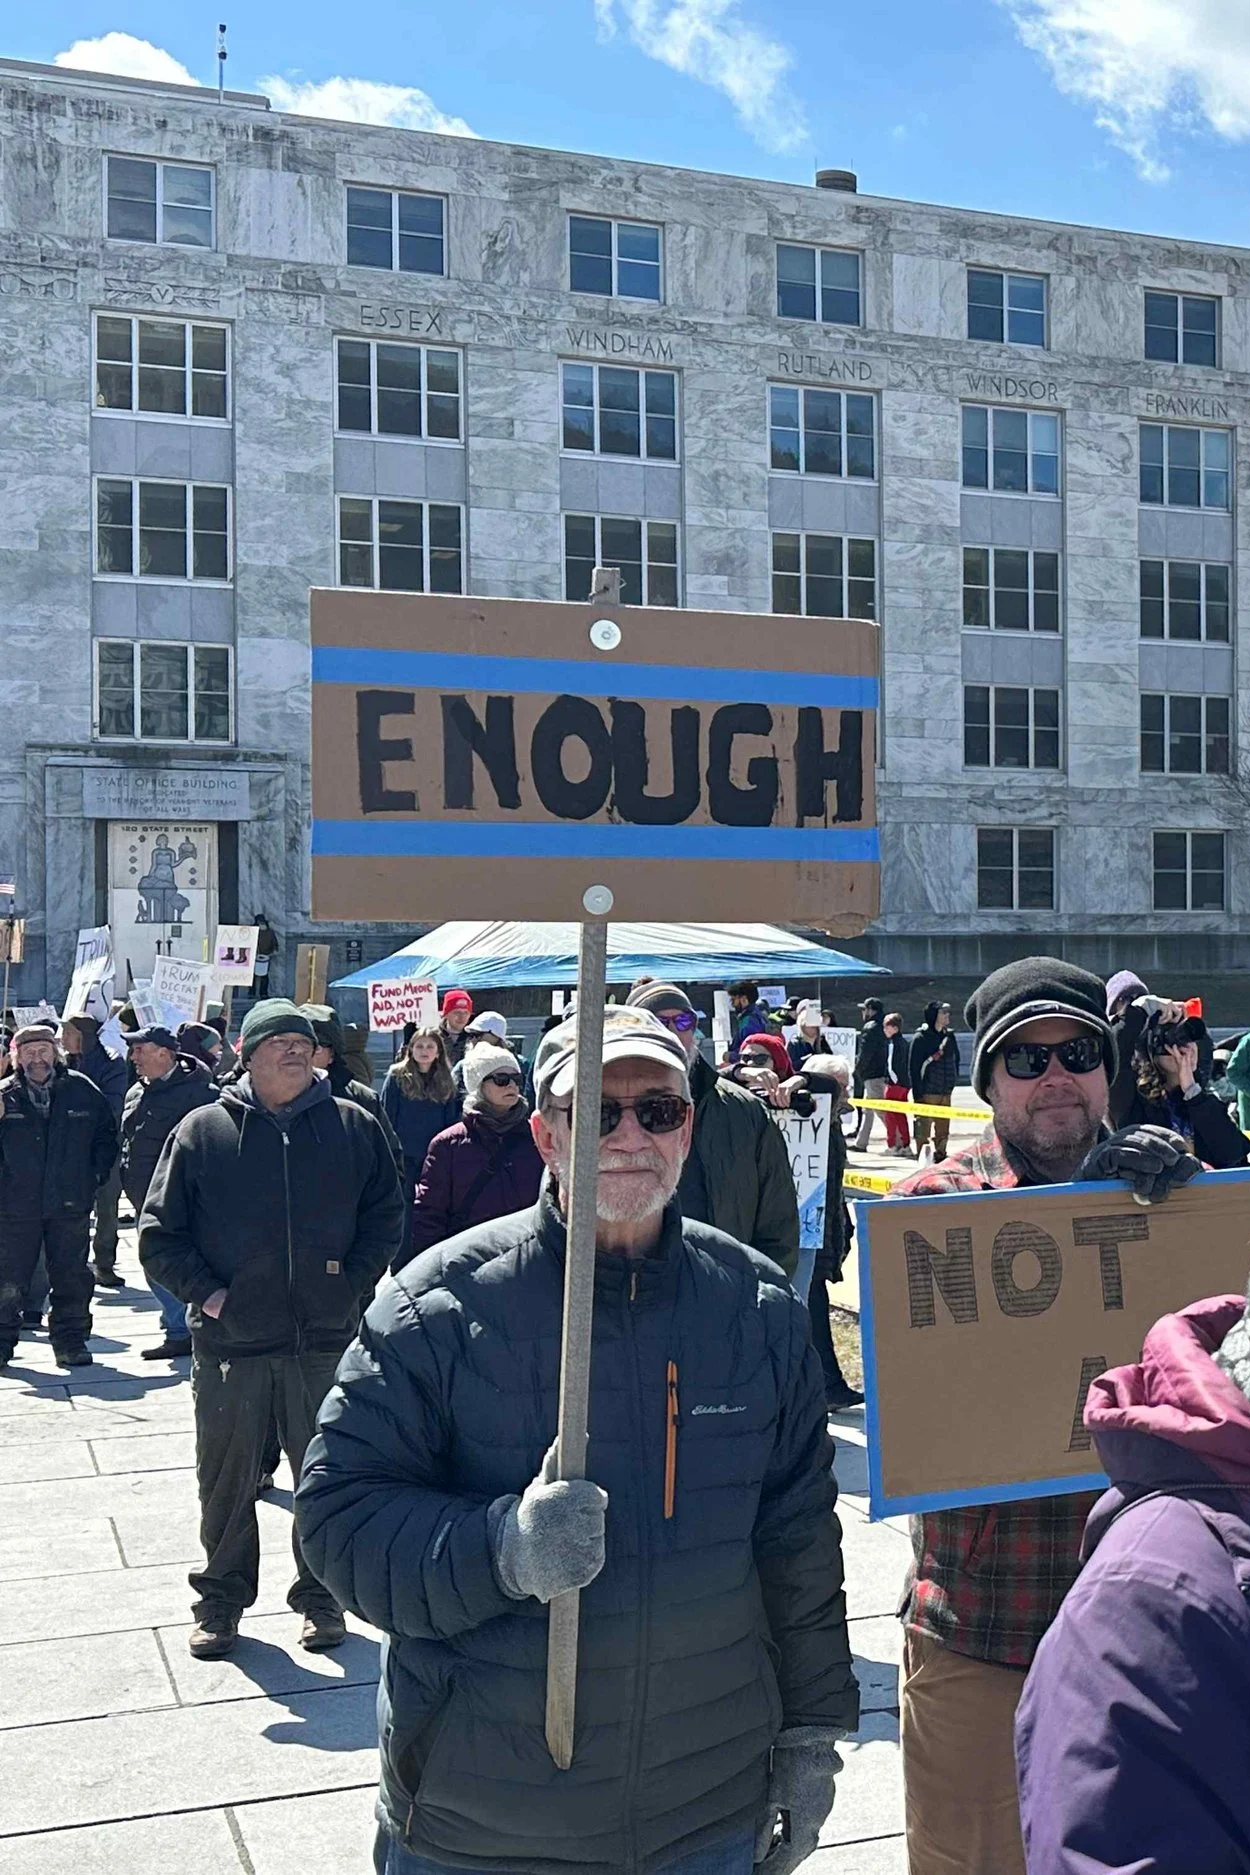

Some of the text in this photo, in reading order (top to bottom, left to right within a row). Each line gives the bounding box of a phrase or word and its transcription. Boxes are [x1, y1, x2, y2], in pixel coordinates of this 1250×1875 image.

[360, 305, 442, 333] ESSEX
[565, 327, 674, 359] WINDHAM
[776, 352, 872, 381] RUTLAND
[966, 372, 1059, 401] WINDSOR
[1146, 393, 1229, 418] FRANKLIN
[355, 689, 864, 828] ENOUGH
[134, 777, 177, 788] OFFICE
[182, 779, 238, 790] BUILDING
[173, 826, 209, 834] STREET
[371, 983, 402, 998] FUND
[372, 997, 423, 1013] AID, NOT
[903, 1213, 1149, 1328] NOT
